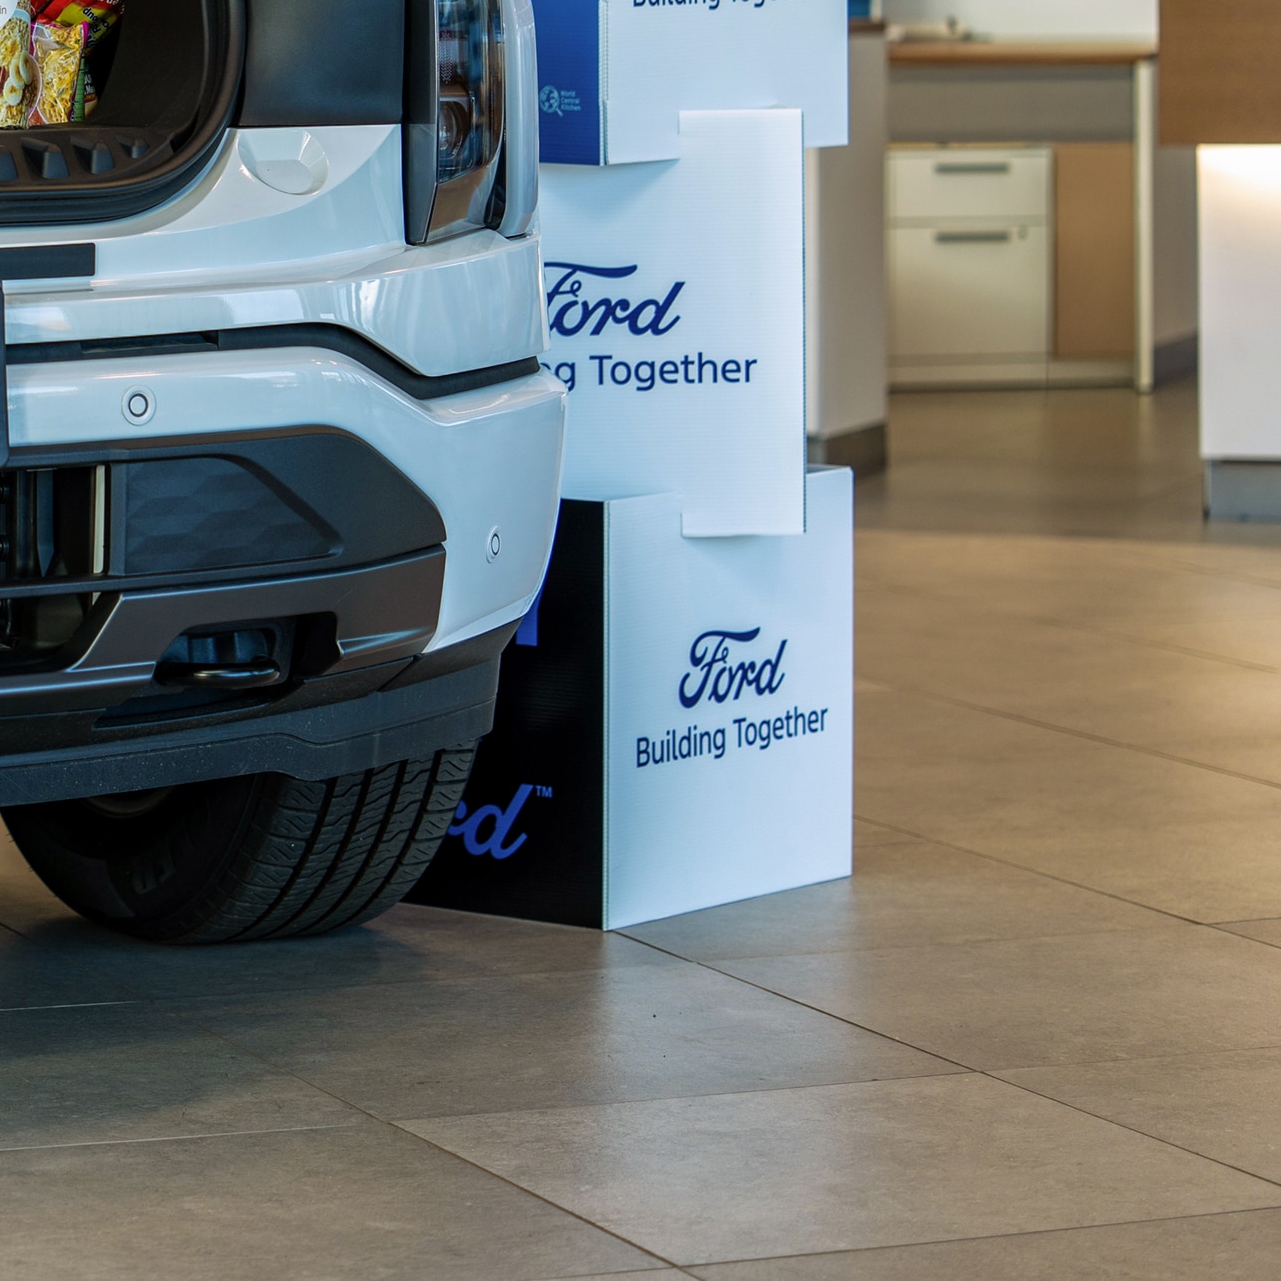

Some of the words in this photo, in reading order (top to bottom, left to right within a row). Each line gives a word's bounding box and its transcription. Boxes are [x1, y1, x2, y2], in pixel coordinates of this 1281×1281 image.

[589, 352, 758, 391] Together
[678, 626, 788, 709] Ford
[636, 725, 726, 768] Building
[733, 705, 828, 750] Together
